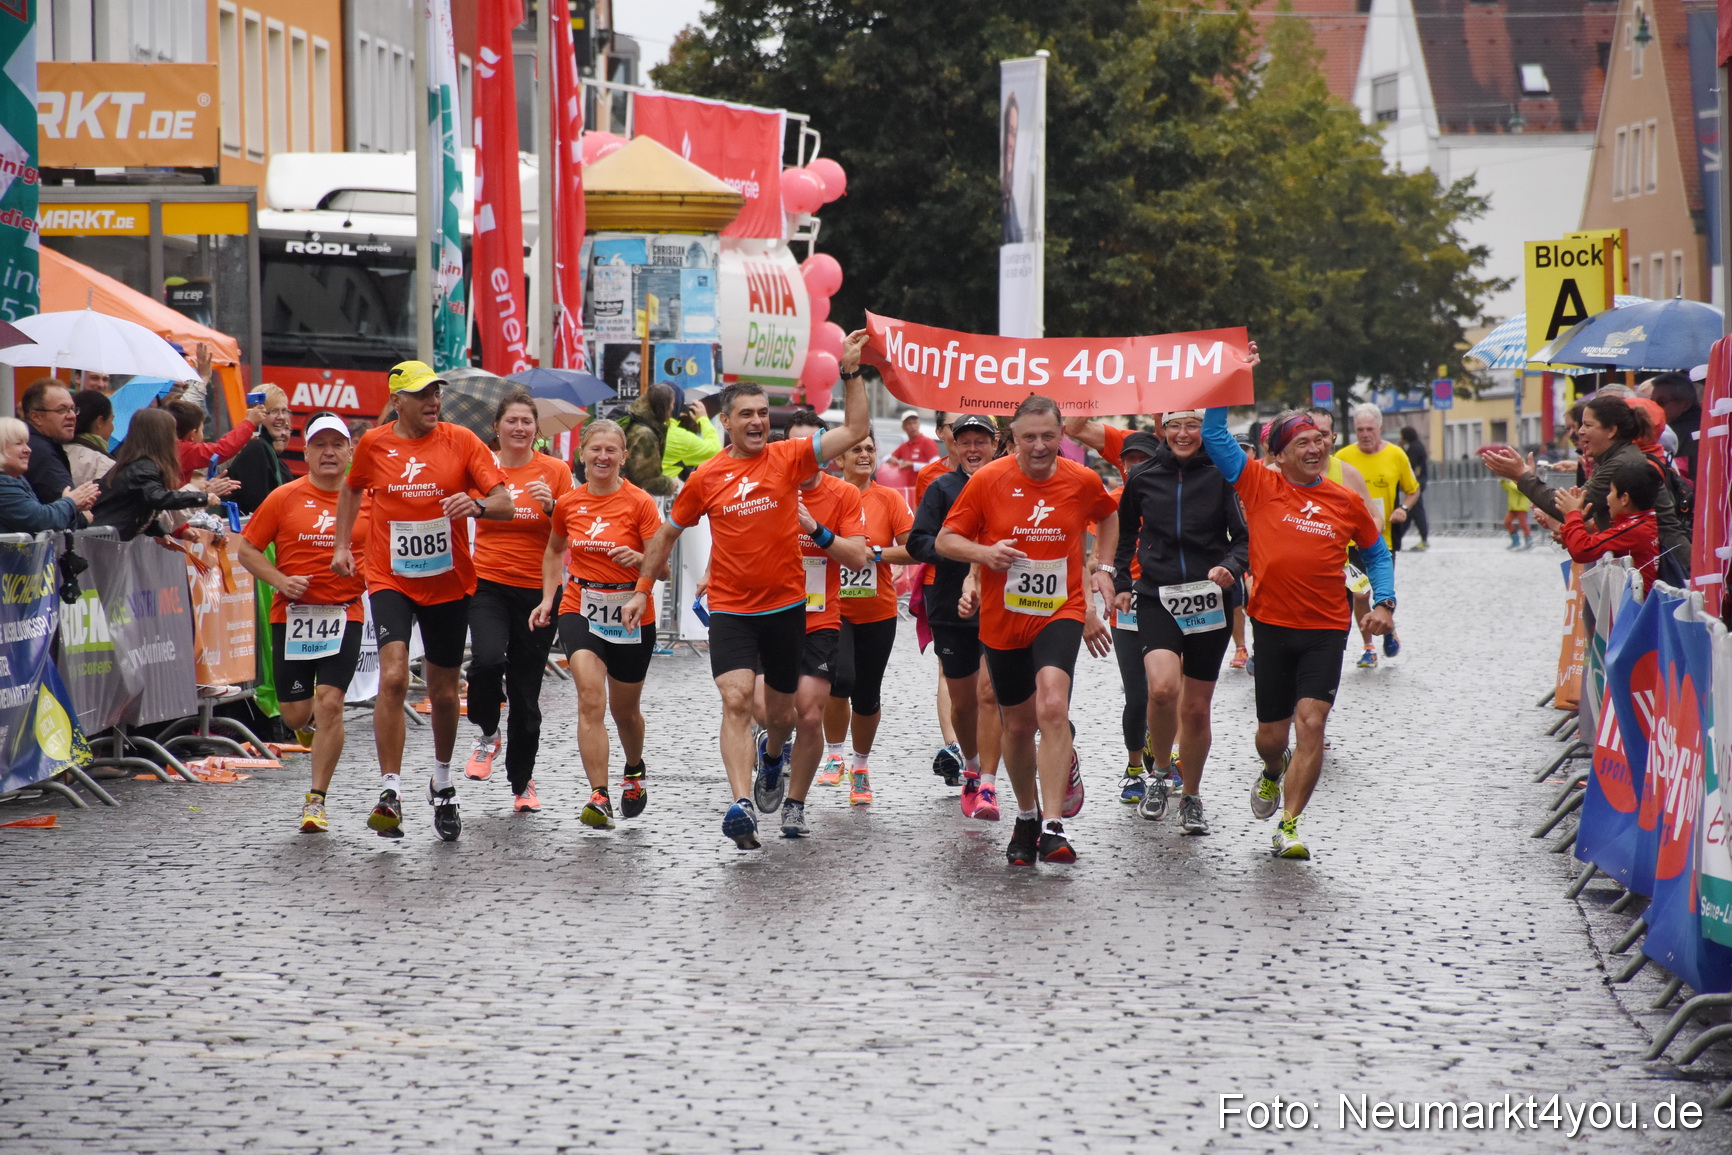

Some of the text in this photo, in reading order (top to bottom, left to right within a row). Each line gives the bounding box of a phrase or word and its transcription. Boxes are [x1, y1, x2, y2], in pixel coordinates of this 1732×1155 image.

[37, 91, 196, 139] RKT.DE
[1535, 243, 1604, 268] Block
[743, 261, 797, 317] AVIA
[1545, 279, 1589, 340] A
[743, 321, 796, 370] Pellets
[885, 326, 1224, 389] Manfreds 40. HM
[960, 395, 1020, 410] funrunners
[388, 483, 437, 493] funrunners
[402, 489, 444, 498] neumarkt
[722, 495, 770, 515] funrunners
[738, 500, 779, 517] neumarkt
[1012, 526, 1061, 535] funrunners
[1282, 514, 1332, 531] funrunners
[1296, 524, 1337, 539] neumarkt
[397, 532, 447, 557] 3085
[572, 539, 616, 548] funrunners
[404, 561, 428, 569] Ernst
[1018, 573, 1057, 595] 330
[1019, 598, 1053, 609] Manfred
[1168, 593, 1217, 616] 2298
[587, 603, 622, 624] 214
[1186, 617, 1205, 627] Erika
[292, 618, 340, 639] 2144
[302, 643, 328, 653] Roland
